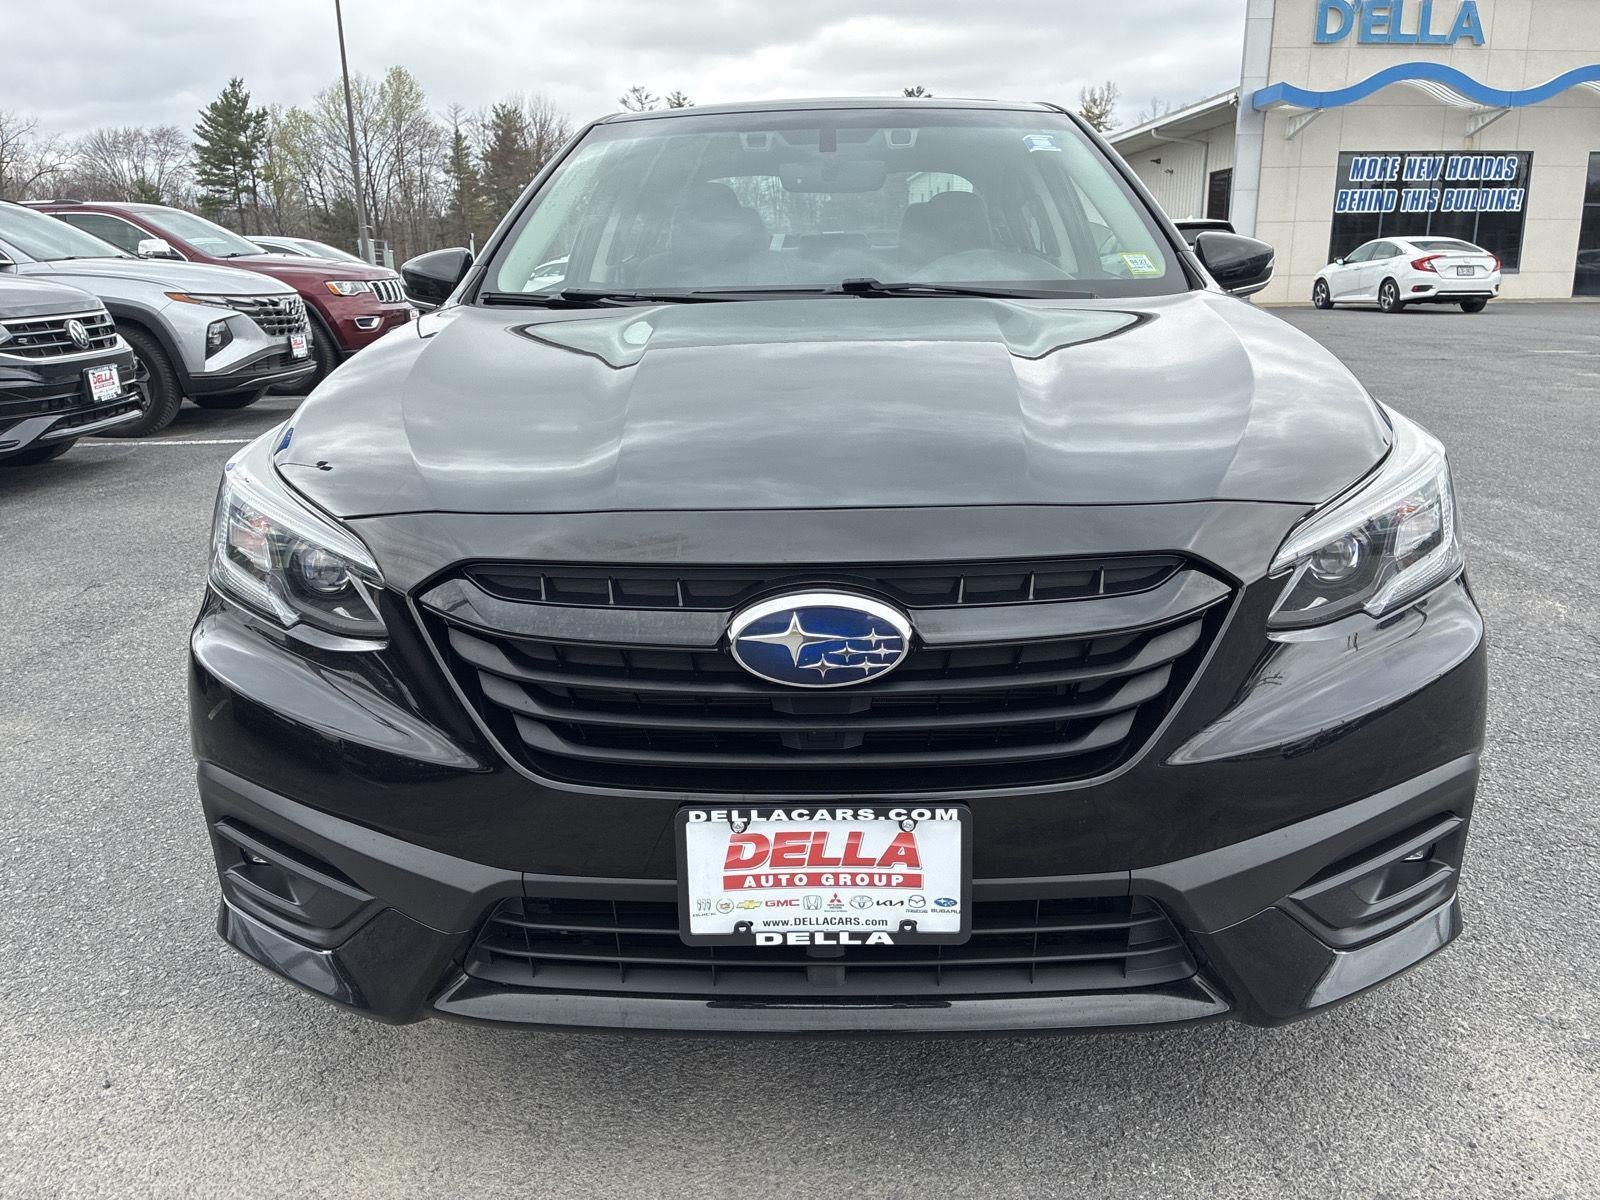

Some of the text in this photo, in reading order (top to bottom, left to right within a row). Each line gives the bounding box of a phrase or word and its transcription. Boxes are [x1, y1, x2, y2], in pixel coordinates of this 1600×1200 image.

[1313, 0, 1485, 45] D'ELLA
[1349, 156, 1517, 181] MORE NEW HONDAS
[1335, 188, 1525, 213] BEHIND THIS BUILDING!
[92, 371, 114, 384] DELLA
[688, 808, 958, 822] DELLACARS.COM
[723, 831, 923, 871] DELLA
[743, 873, 904, 888] AUTO GROUP
[765, 899, 800, 907] GMC
[762, 917, 888, 927] www.DELLACARS.com
[755, 931, 895, 945] DELLA
